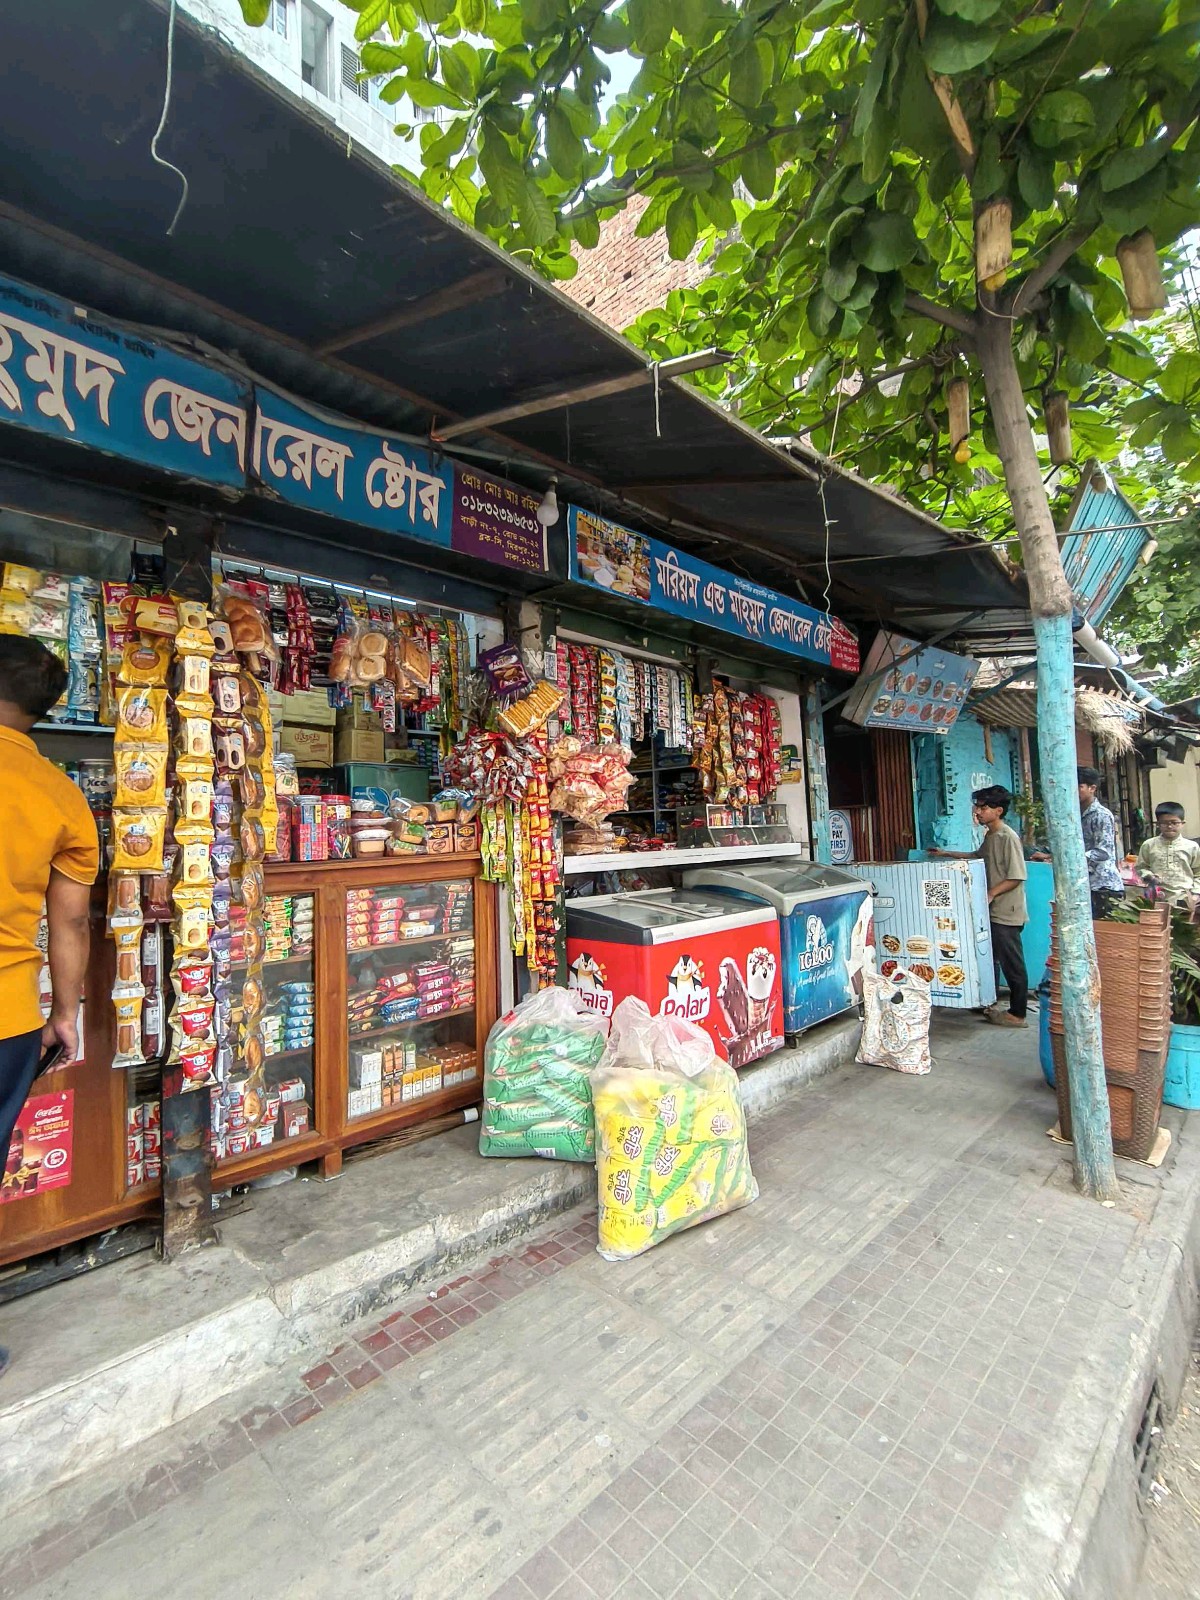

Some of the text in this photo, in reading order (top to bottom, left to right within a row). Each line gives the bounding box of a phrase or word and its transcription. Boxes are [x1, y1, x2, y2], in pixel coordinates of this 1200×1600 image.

[144, 379, 354, 500] জেনারেল
[365, 441, 446, 529] ষ্টোর
[461, 472, 481, 491] প্রোঃ
[484, 481, 502, 499] মোঃ
[504, 488, 518, 506] আঃ
[461, 495, 539, 534] ০১৮৩২৩৯৬৫৩১
[654, 551, 701, 608] মরিয়ম
[703, 581, 726, 614] এন্ড
[768, 607, 813, 649] জেনারেল
[830, 839, 846, 849] FIRST
[832, 830, 843, 839] PAY
[799, 945, 833, 971] IGLOO
[664, 994, 707, 1018] Polar
[623, 1126, 644, 1159] রুচি
[654, 1147, 680, 1176] রুচি
[614, 1170, 632, 1205] রুচি
